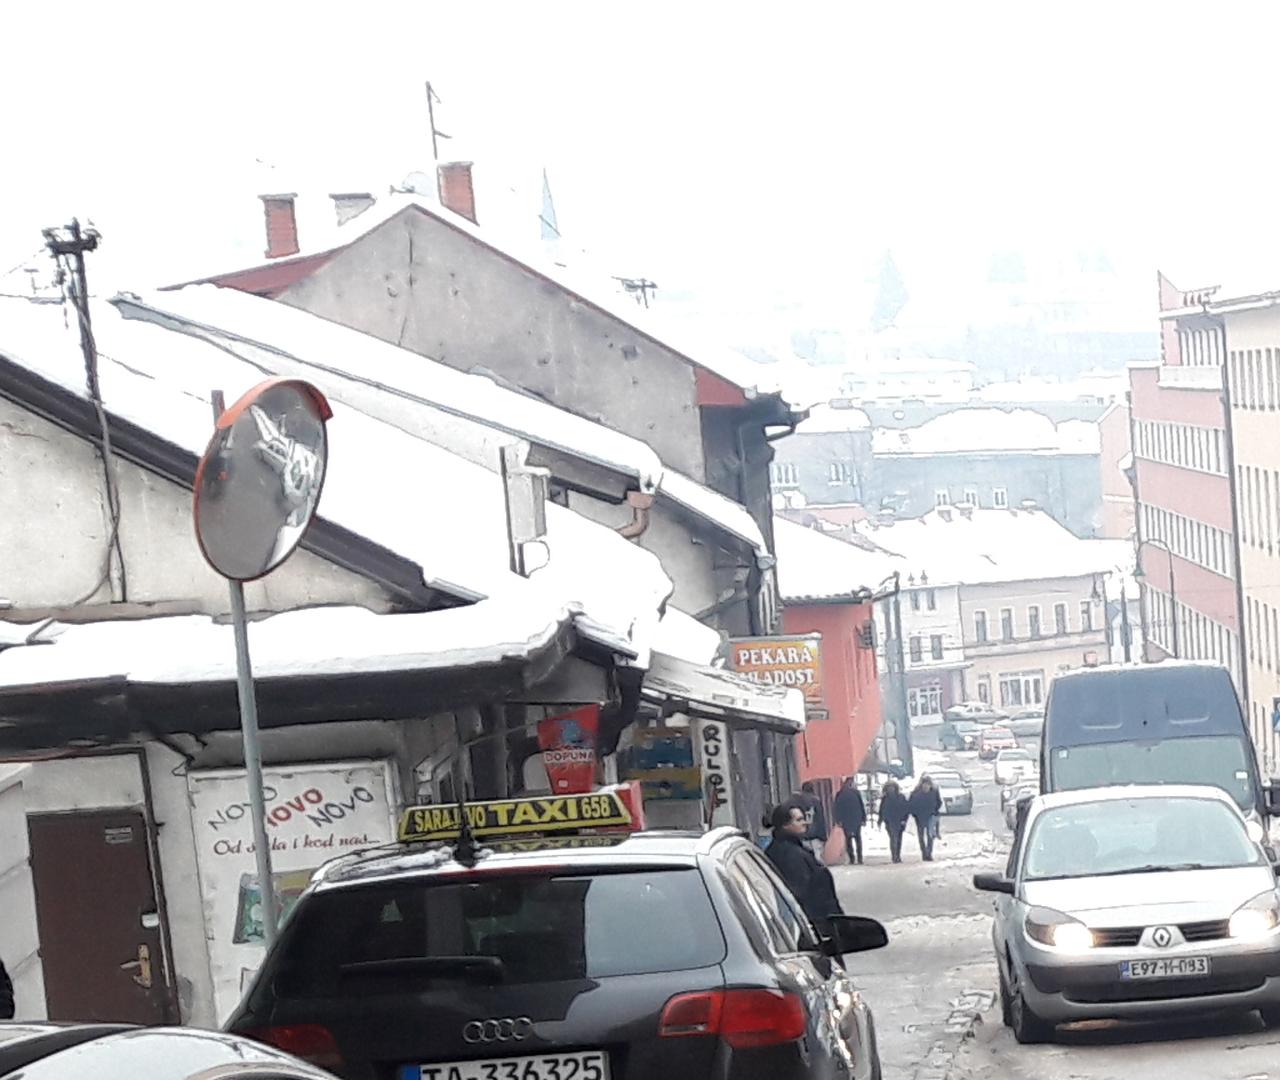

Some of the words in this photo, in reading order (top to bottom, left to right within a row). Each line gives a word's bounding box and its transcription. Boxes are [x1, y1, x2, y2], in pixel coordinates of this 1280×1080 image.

[739, 647, 812, 666] PEKARA
[208, 786, 278, 832] NOO
[307, 786, 375, 828] NOVO
[414, 804, 487, 833] SARAJVO
[488, 797, 579, 826] TAXI
[581, 795, 611, 818] 658
[213, 839, 242, 856] Od
